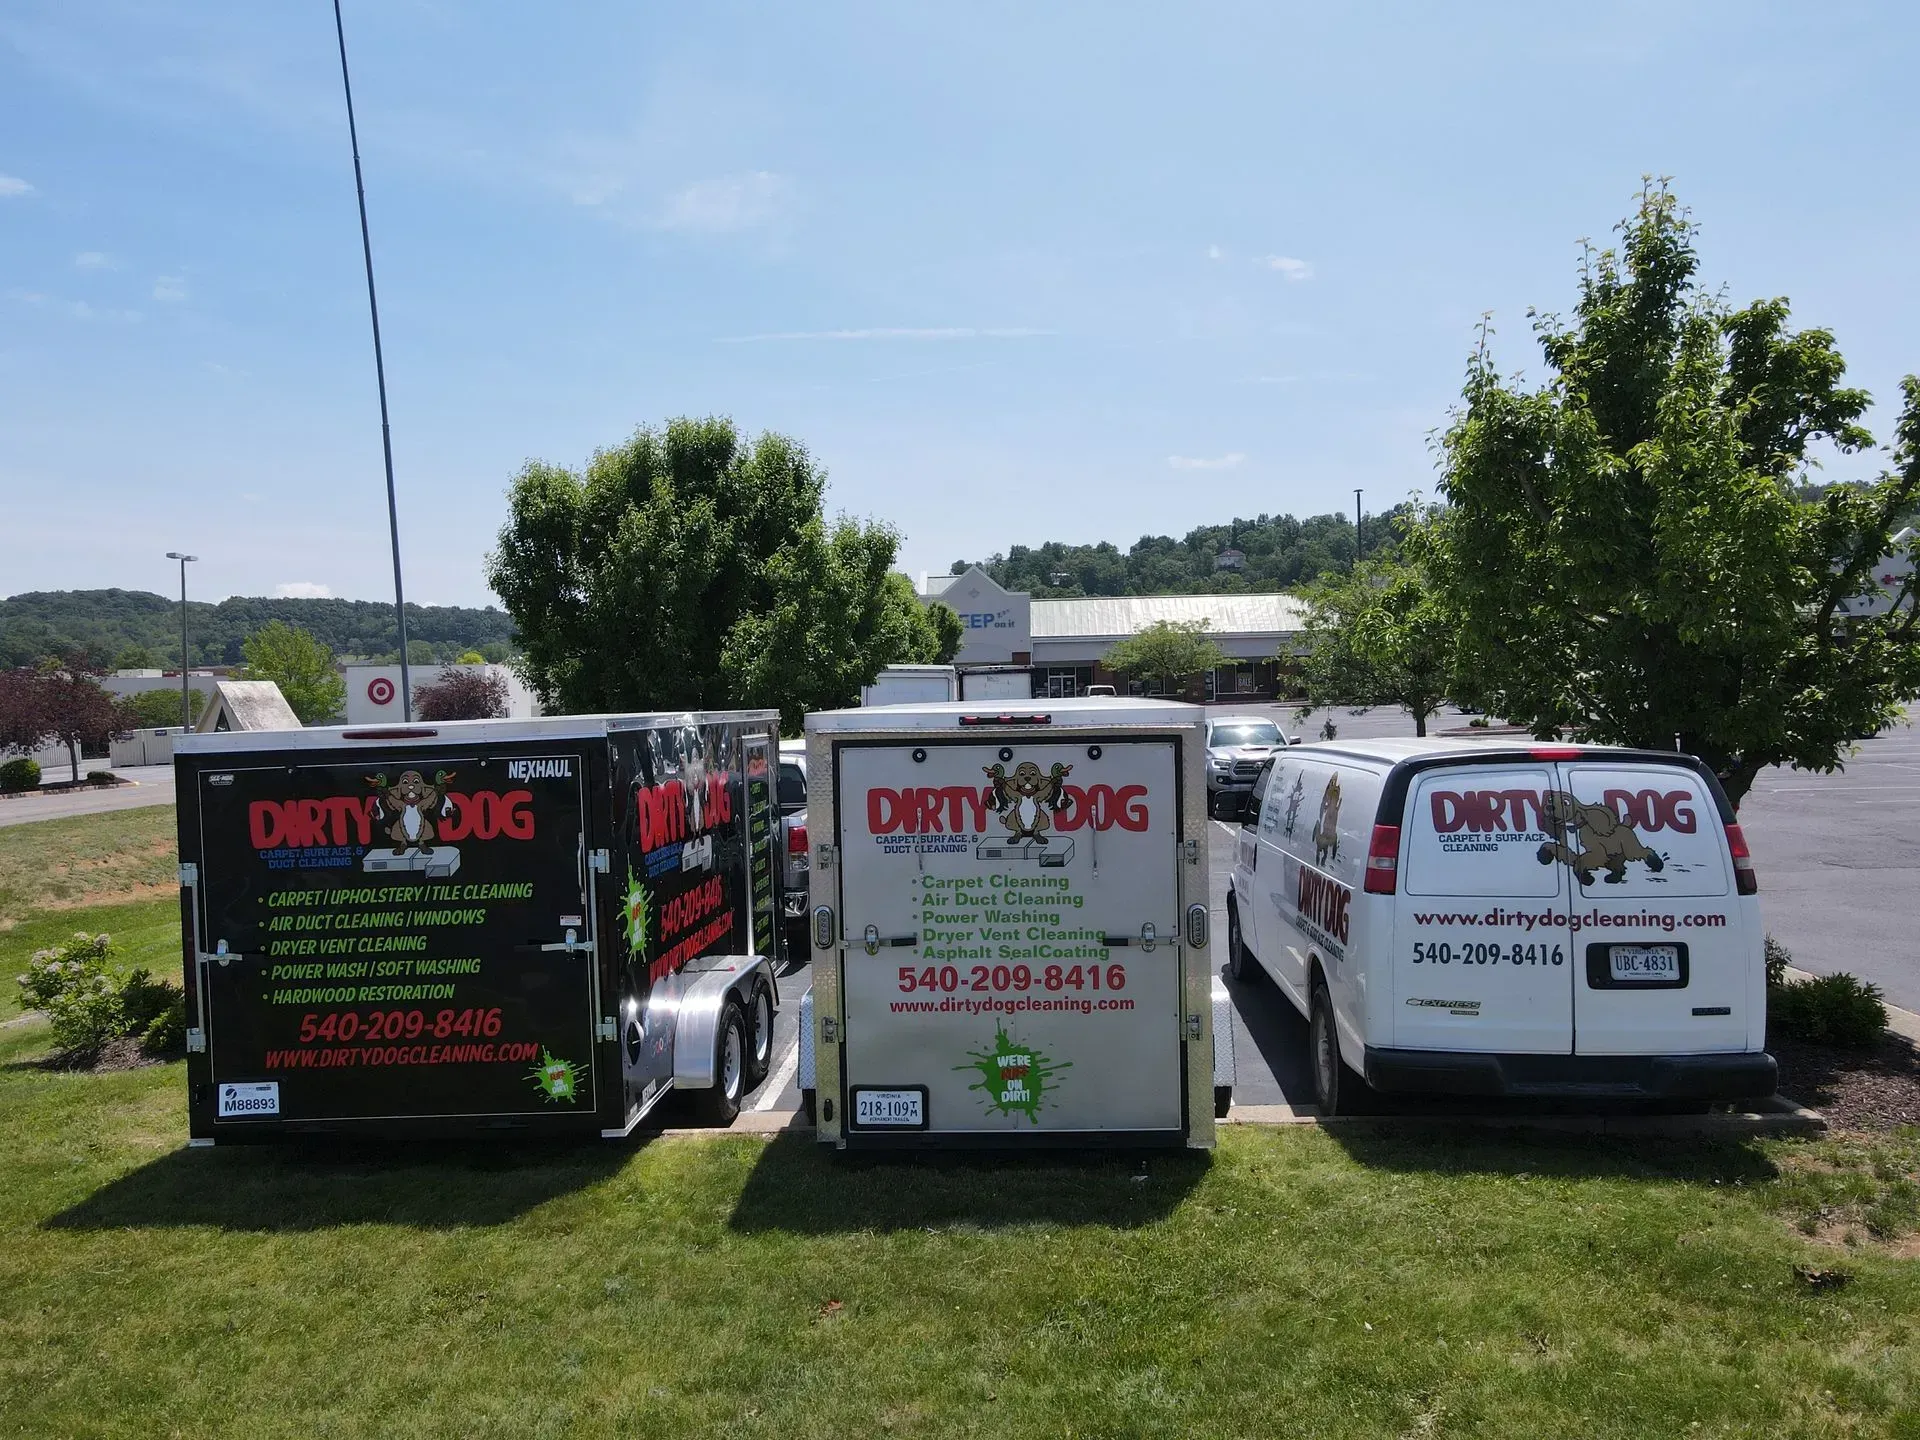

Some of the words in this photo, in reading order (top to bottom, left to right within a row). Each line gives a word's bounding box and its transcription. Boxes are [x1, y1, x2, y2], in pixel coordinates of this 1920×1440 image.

[508, 759, 572, 783] NEXHAUL
[249, 796, 377, 849] DIRTY
[436, 790, 535, 842] DOG
[638, 779, 685, 853] DIRTY
[867, 786, 993, 834] DIRTY
[1052, 784, 1149, 832] DOG
[1430, 790, 1549, 833] DIRTY
[1604, 790, 1697, 834] DOG
[1439, 834, 1481, 843] CARPET
[1485, 834, 1492, 842] &
[1495, 833, 1546, 842] SURFACE
[1443, 843, 1499, 852] CLEANING
[884, 845, 913, 854] DUCT
[915, 844, 967, 853] CLEANING
[268, 859, 296, 869] DUCT
[299, 857, 352, 868] CLEANING
[922, 875, 983, 891] Carpet
[990, 874, 1069, 890] Cleaning
[268, 890, 323, 907] CARPET
[330, 886, 424, 905] UPHOLSTERY
[432, 885, 461, 901] TILE
[463, 882, 534, 900] CLEANING
[922, 892, 949, 906] Air
[955, 892, 997, 906] Duct
[1004, 892, 1084, 908] Cleaning
[268, 916, 293, 932] AIR
[295, 914, 333, 931] DUCT
[334, 911, 404, 930] CLEANING
[413, 908, 486, 927] WINDOWS
[922, 910, 979, 924] Power
[985, 910, 1060, 926] Washing
[1324, 880, 1351, 946] DOG
[1413, 908, 1727, 932] www.dirtydogcleaning.com
[270, 939, 317, 956] DRYER
[320, 938, 357, 954] VENT
[357, 935, 427, 953] CLEANING
[923, 928, 973, 944] Dryer
[979, 928, 1020, 941] Vent
[1026, 926, 1107, 942] Cleaning
[922, 945, 992, 962] Asphalt
[998, 944, 1110, 961] SealCoating
[1412, 942, 1564, 966] 540-209-8416
[1614, 955, 1675, 971] UBC-4831
[271, 964, 324, 980] POWER
[326, 962, 368, 978] WASH
[376, 960, 414, 977] SOFT
[415, 958, 481, 976] WASHING
[898, 964, 1126, 993] 540-209-8416
[272, 987, 356, 1005] HARDWOOD
[358, 983, 456, 1002] RESTORATION
[1420, 999, 1481, 1009] EXPRESS
[890, 996, 1135, 1015] www.dirtydogcleaning.com
[299, 1008, 502, 1043] 540-209-8416
[265, 1043, 539, 1069] WWW.DIRTYDOGCLEANING.COM
[224, 1098, 276, 1111] M88893
[1001, 1089, 1030, 1103] DIRT!
